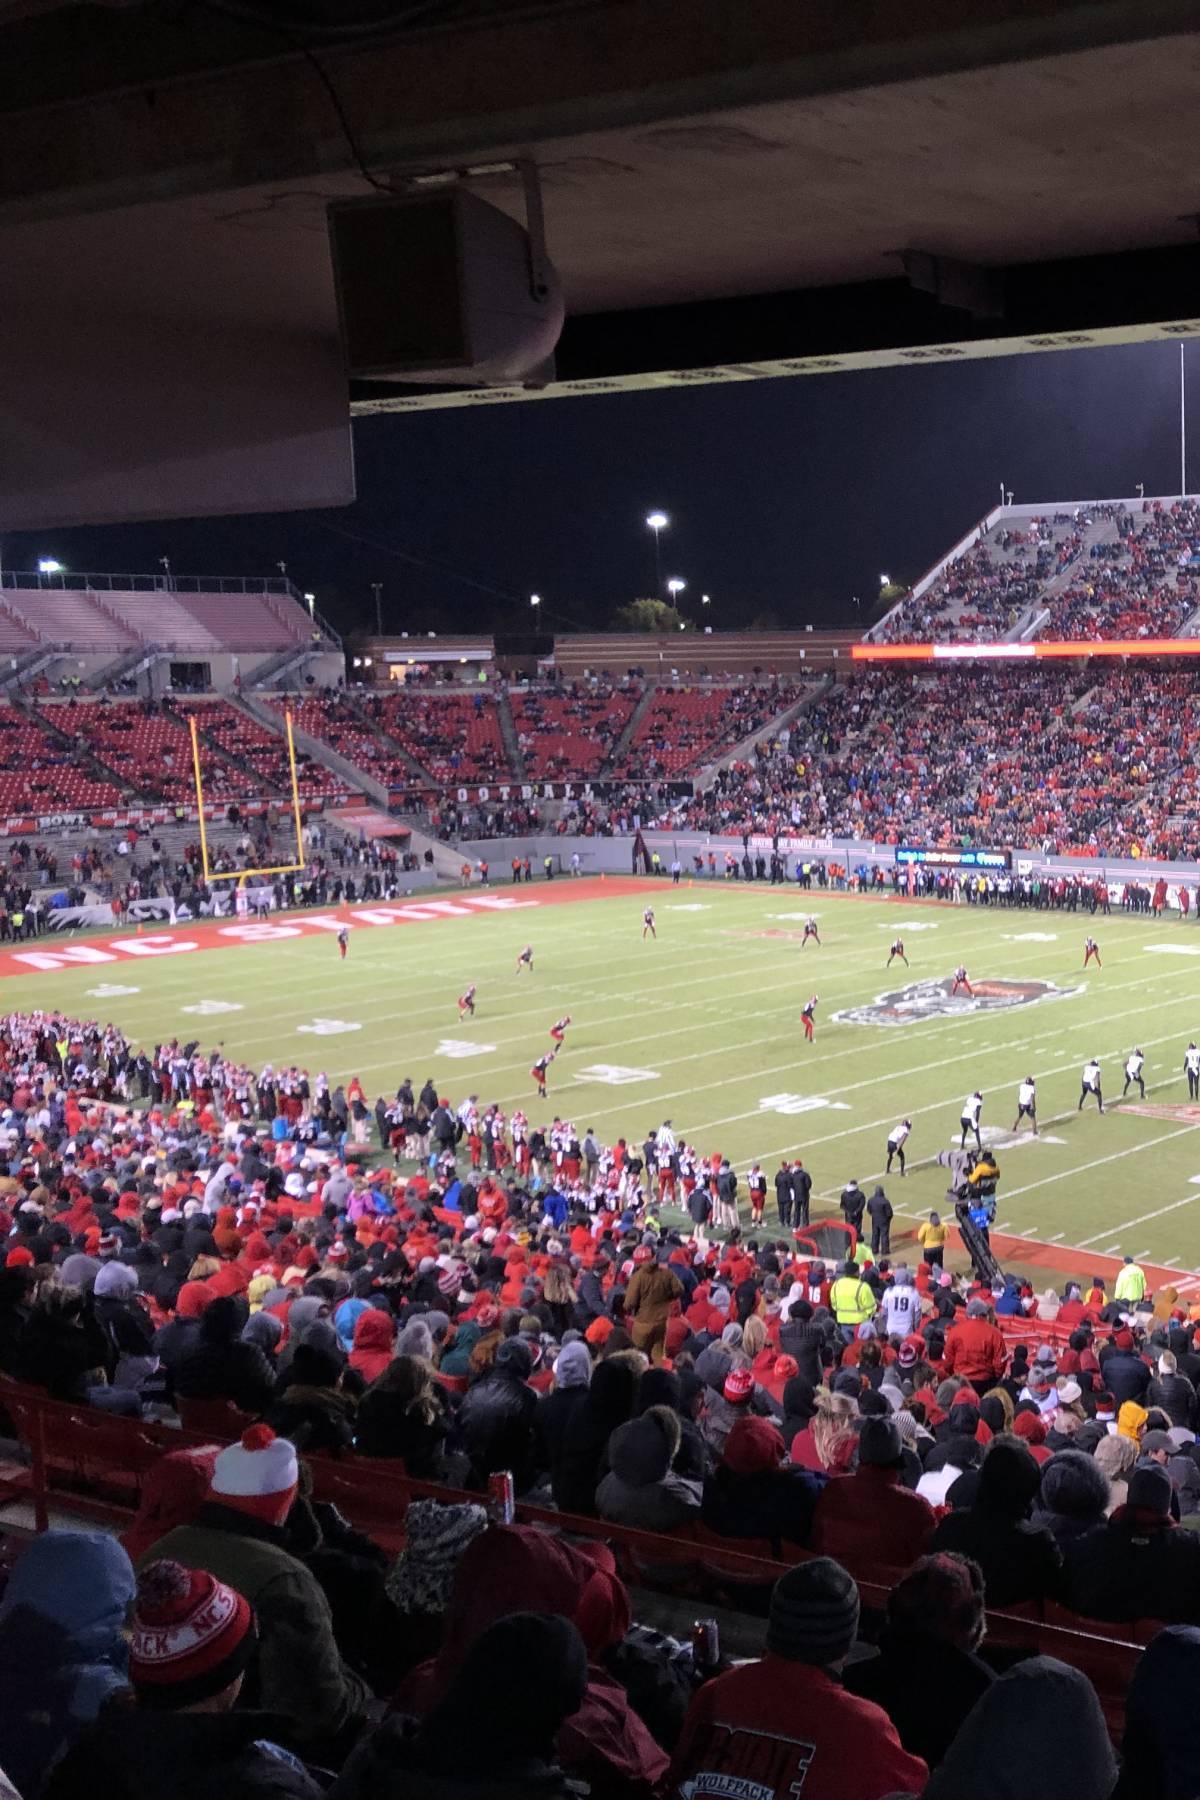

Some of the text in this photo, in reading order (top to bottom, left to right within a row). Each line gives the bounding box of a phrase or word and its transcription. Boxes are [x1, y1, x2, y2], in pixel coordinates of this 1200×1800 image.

[10, 895, 539, 969] NC STATE
[894, 1296, 909, 1312] 19
[696, 1774, 773, 1800] WOLFPACK
